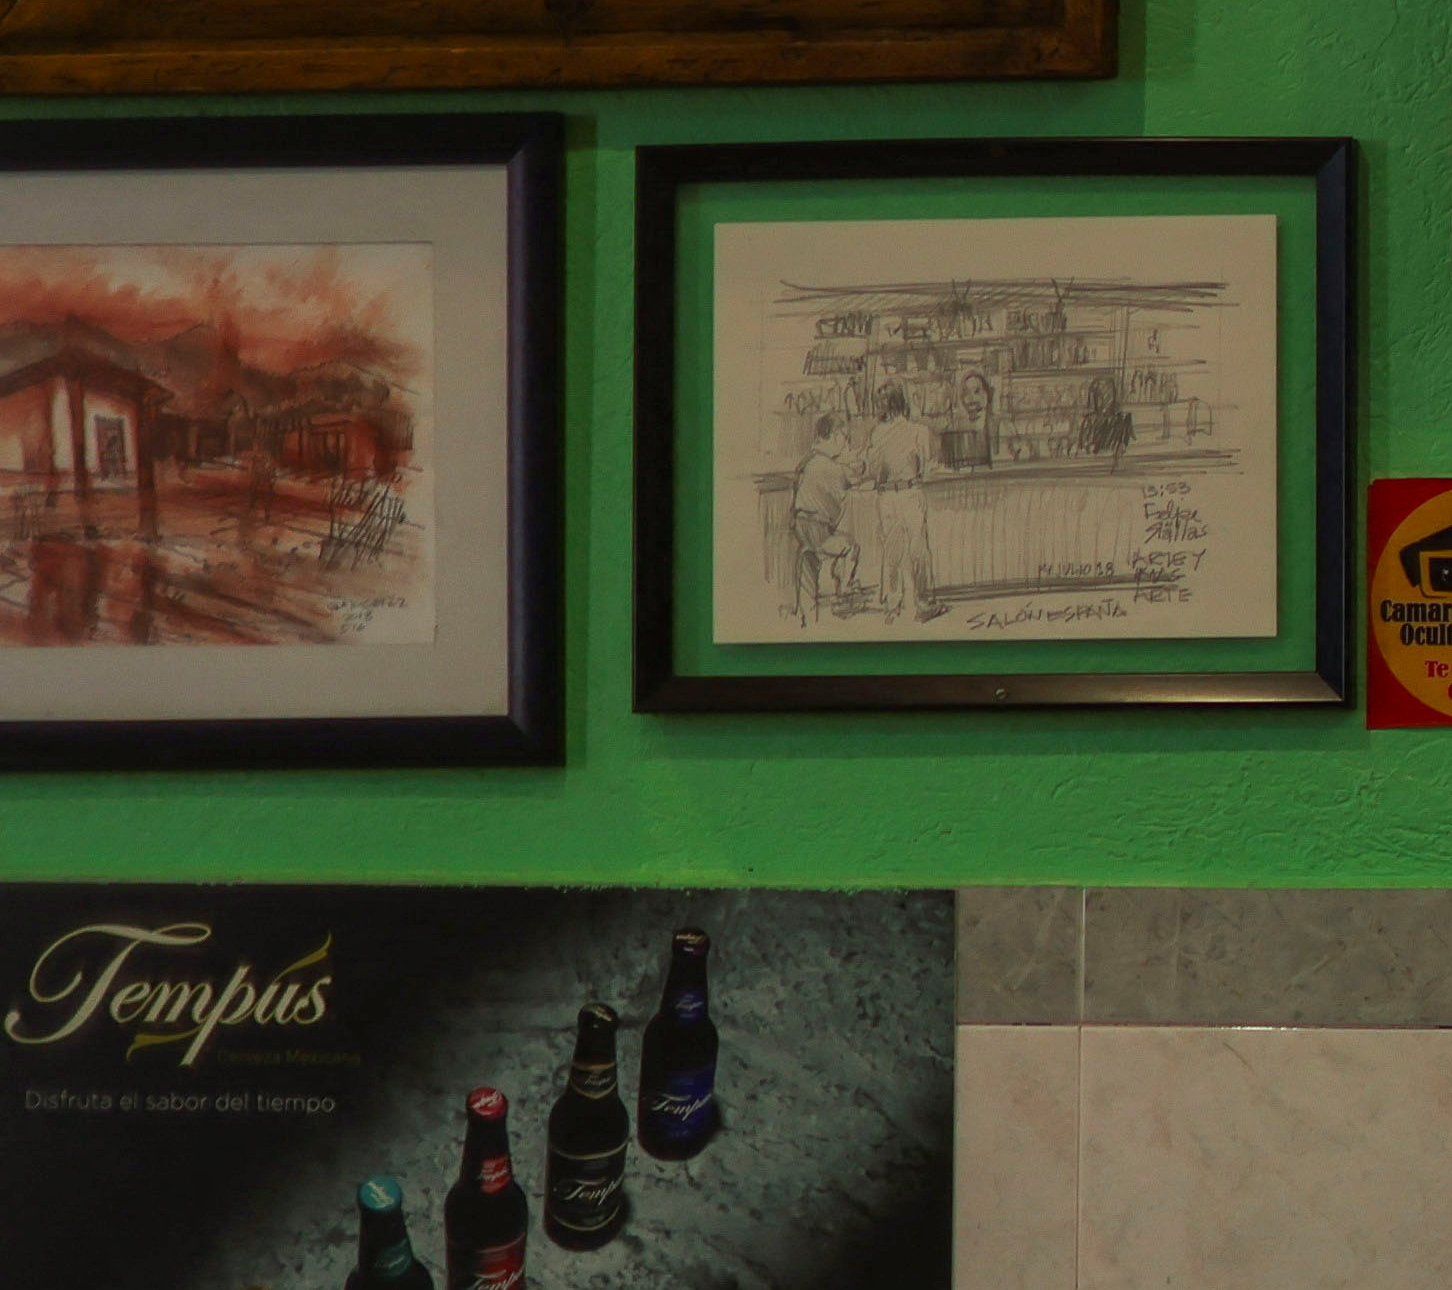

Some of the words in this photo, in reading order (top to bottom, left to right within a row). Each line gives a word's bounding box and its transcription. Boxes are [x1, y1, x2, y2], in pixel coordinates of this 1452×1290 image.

[1424, 660, 1450, 679] Te
[5, 923, 333, 1067] Tempus
[25, 1089, 113, 1110] Disfruta
[120, 1089, 135, 1110] el
[146, 1089, 207, 1110] sabor
[215, 1089, 249, 1110] del
[257, 1090, 336, 1114] tiempo
